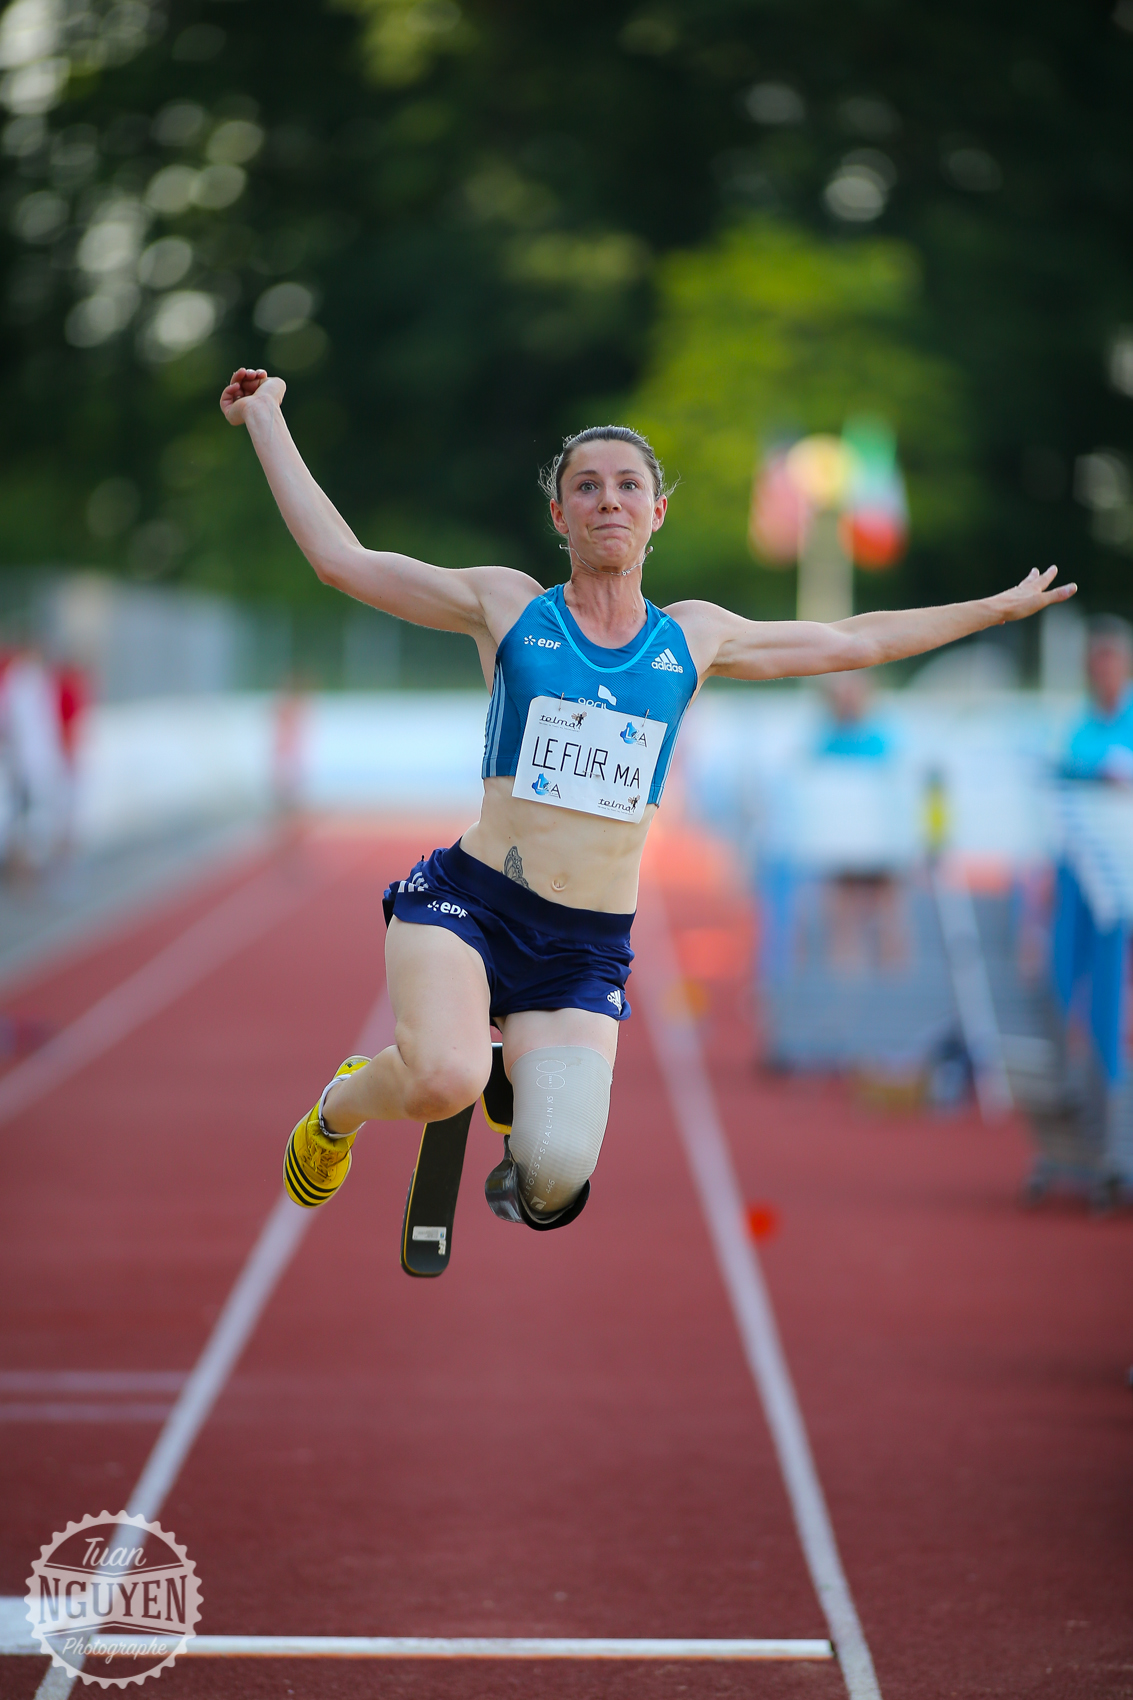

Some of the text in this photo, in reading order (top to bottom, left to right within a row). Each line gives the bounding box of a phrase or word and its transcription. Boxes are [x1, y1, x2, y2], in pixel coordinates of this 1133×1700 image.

[651, 660, 683, 674] adidas
[531, 736, 559, 771] LE
[560, 742, 609, 781] FUR
